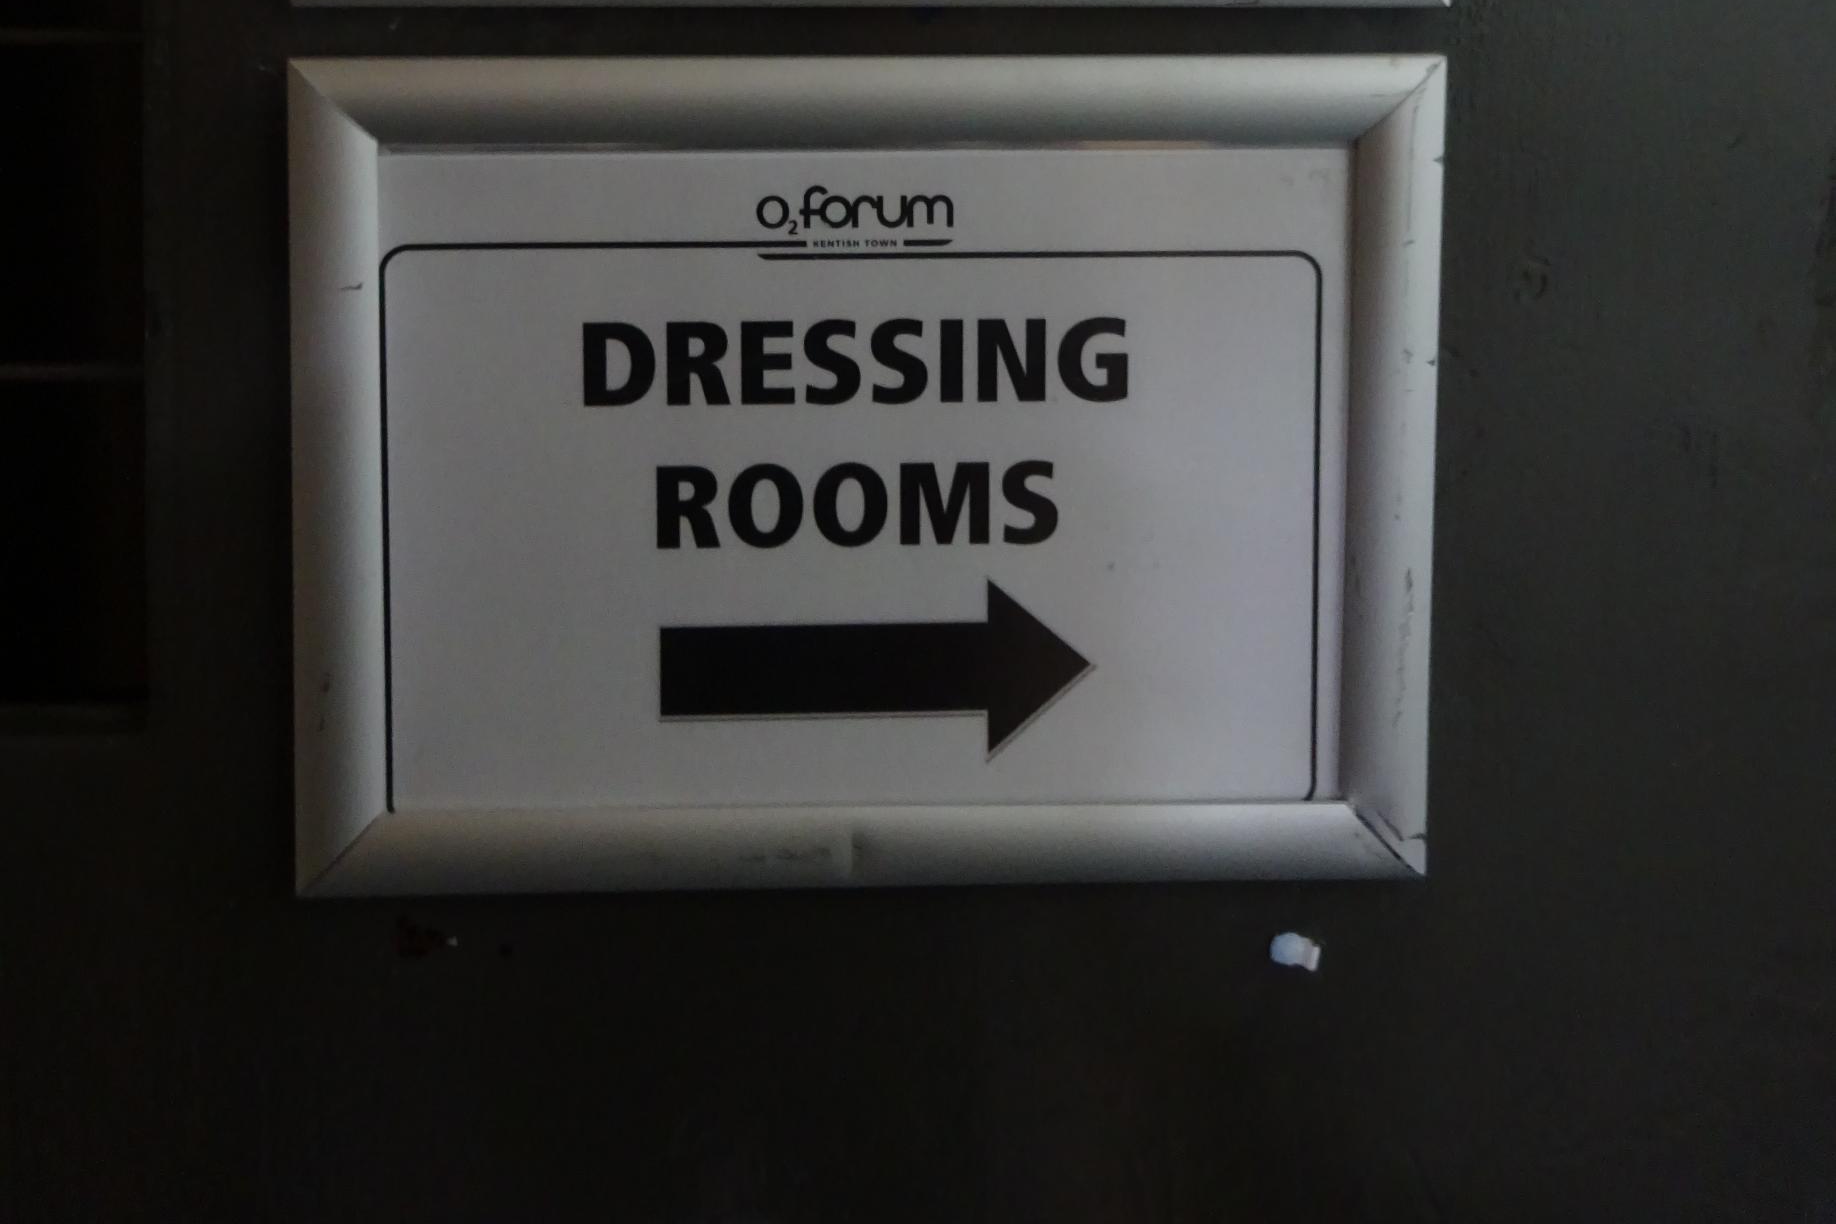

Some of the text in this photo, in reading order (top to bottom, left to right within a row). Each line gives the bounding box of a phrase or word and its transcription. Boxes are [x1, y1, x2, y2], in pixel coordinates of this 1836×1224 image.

[813, 239, 898, 248] KENTISH TOWN
[583, 317, 1128, 408] DRESSING
[656, 460, 1059, 550] ROOMS
